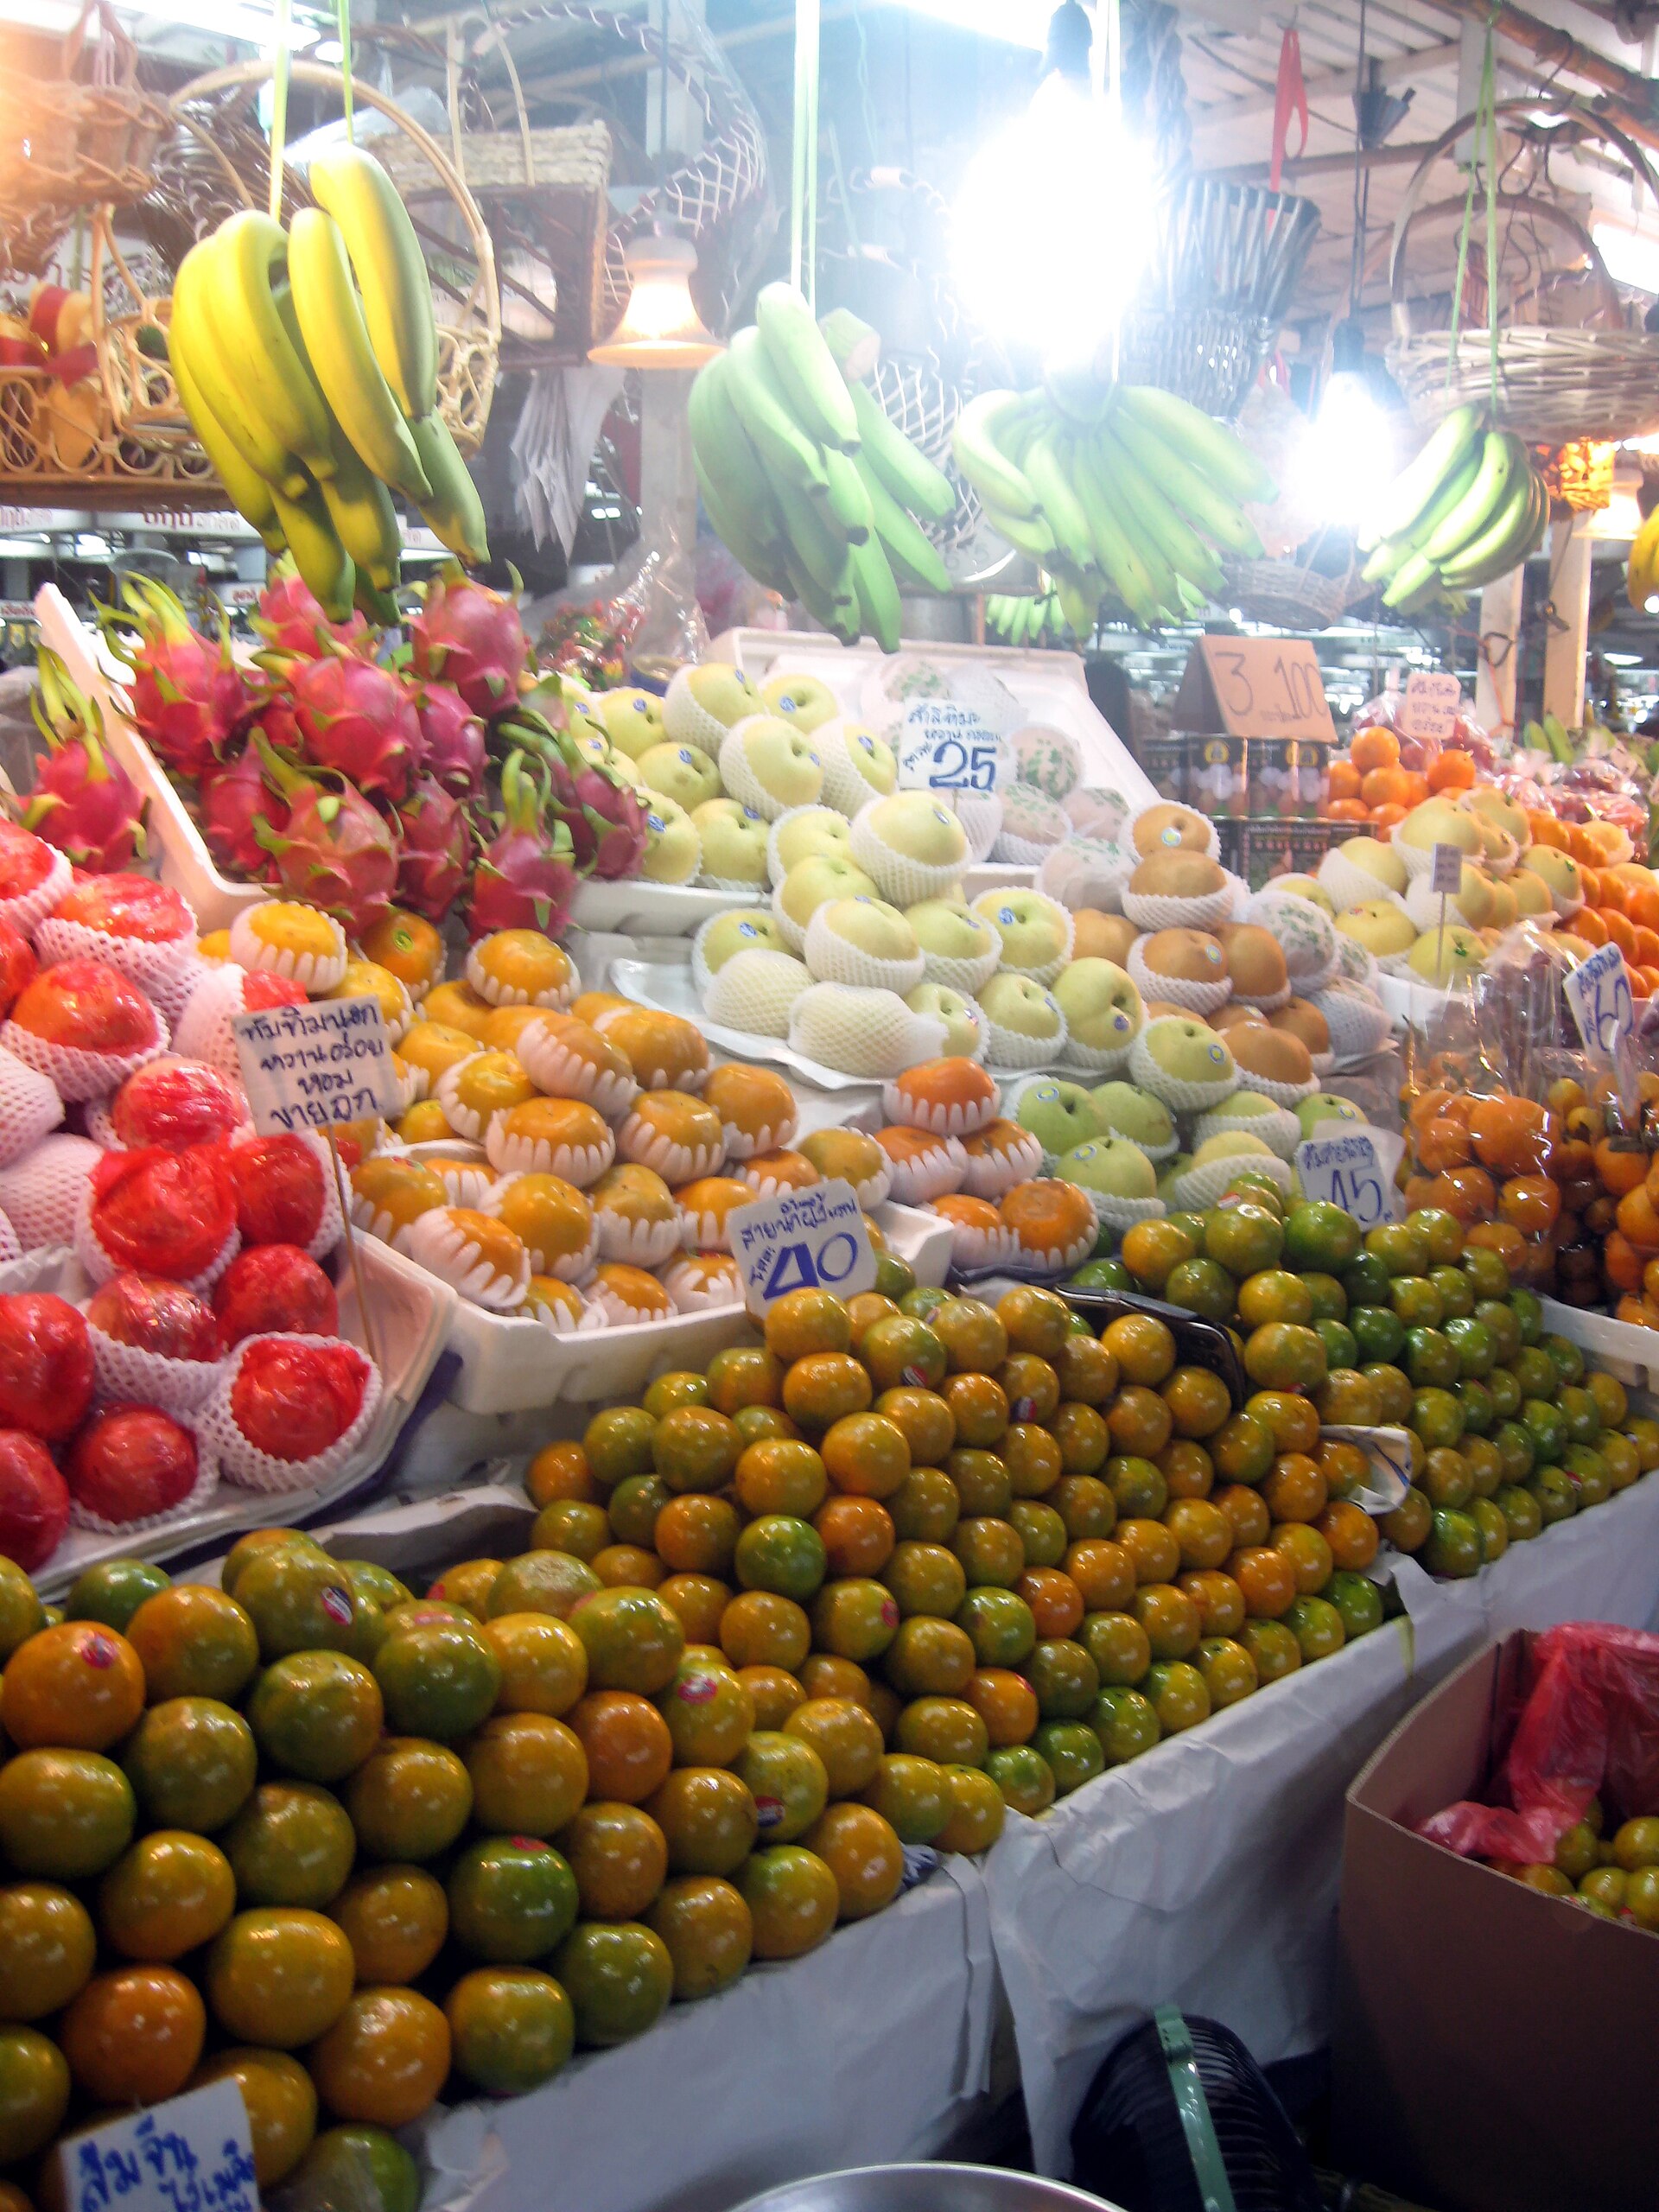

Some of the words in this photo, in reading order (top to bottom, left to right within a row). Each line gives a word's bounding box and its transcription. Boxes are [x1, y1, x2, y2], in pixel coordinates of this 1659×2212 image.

[1214, 651, 1254, 716] 3
[1274, 655, 1329, 720] 100
[929, 740, 996, 792] 25
[762, 1230, 859, 1301] 40
